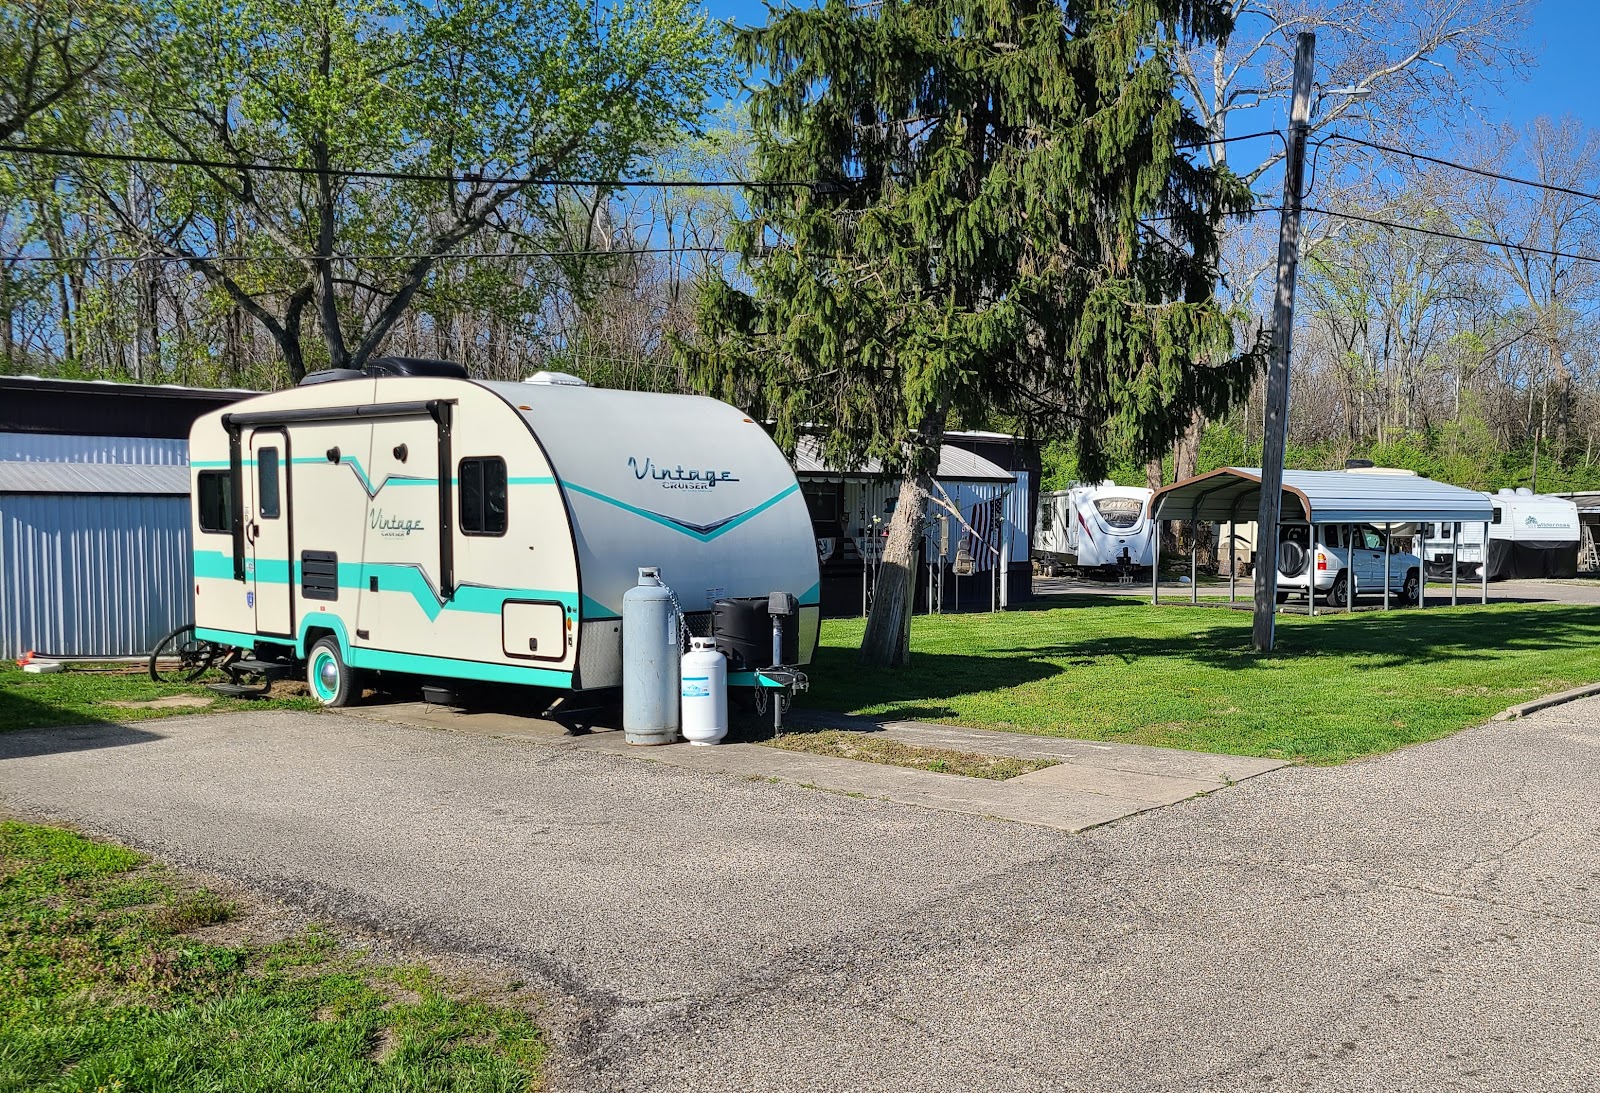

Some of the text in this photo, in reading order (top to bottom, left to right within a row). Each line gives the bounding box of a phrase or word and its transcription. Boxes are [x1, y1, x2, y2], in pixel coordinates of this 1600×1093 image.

[627, 456, 740, 487] Vintage
[661, 481, 709, 490] CRUISER
[369, 507, 425, 536] Vintage
